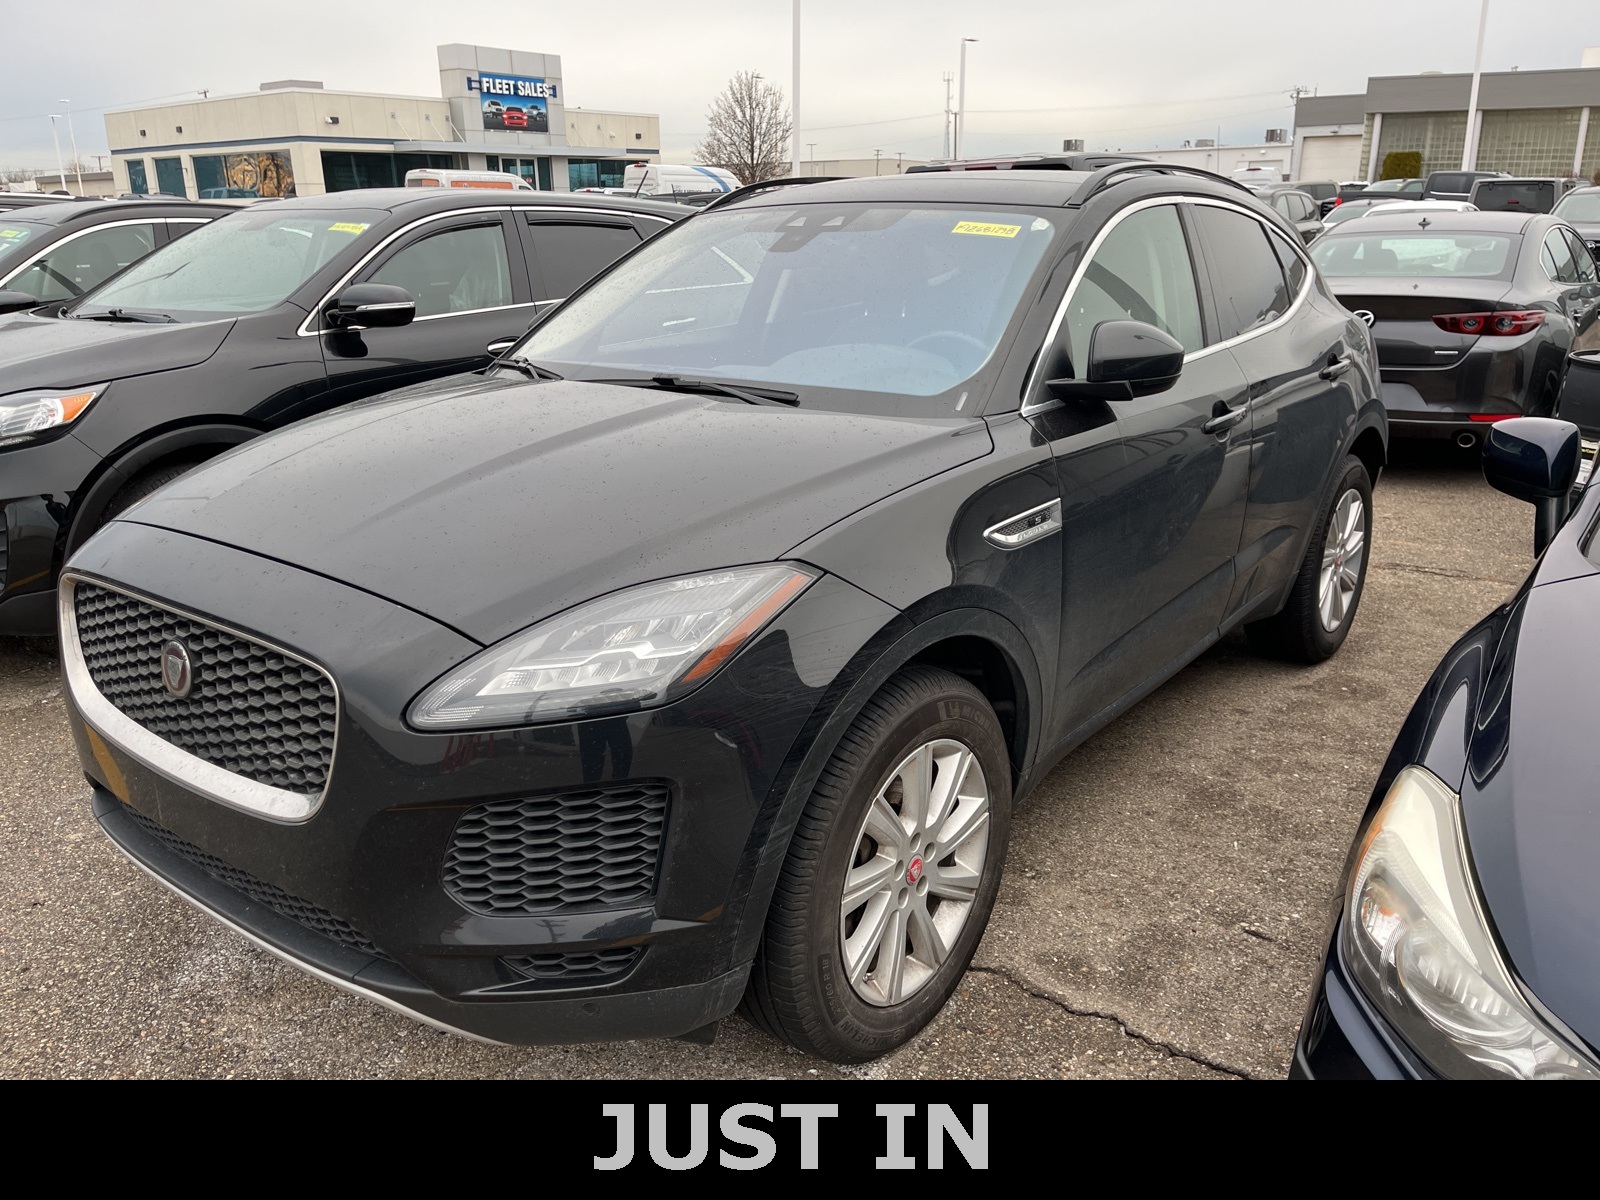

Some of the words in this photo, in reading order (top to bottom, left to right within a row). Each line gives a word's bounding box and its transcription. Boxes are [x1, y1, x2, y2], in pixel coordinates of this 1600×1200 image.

[481, 77, 515, 95] FLEET
[517, 80, 549, 98] SALES
[1018, 524, 1049, 541] JAGUAR
[961, 705, 995, 738] MICHEL
